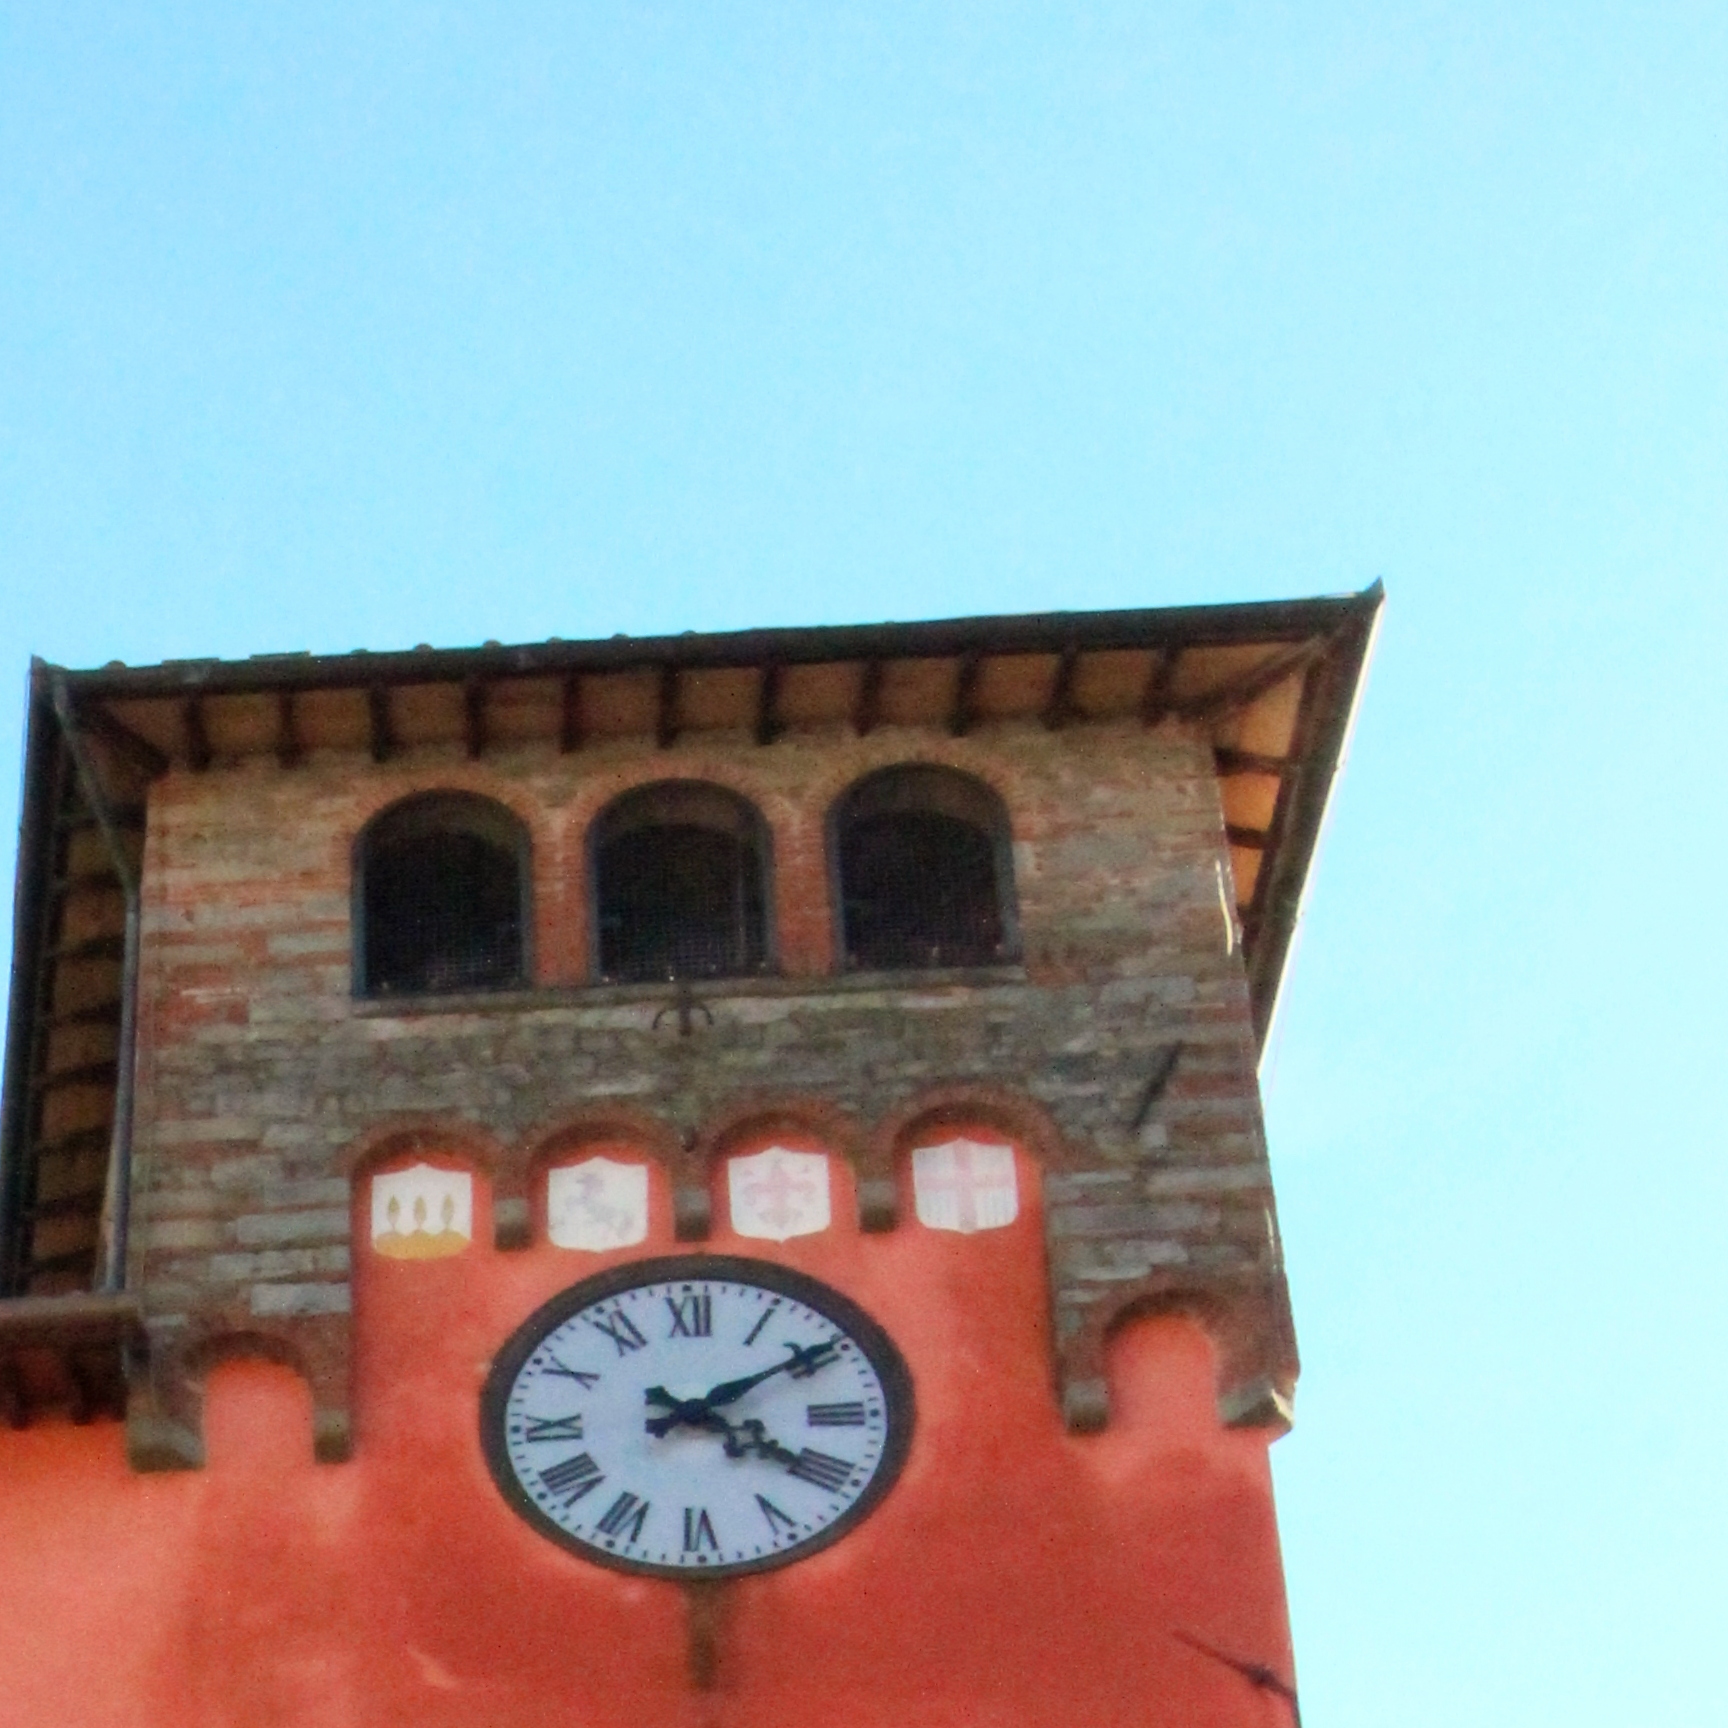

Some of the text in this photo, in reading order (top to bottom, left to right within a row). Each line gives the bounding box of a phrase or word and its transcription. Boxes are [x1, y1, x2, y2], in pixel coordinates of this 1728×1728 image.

[592, 1310, 648, 1357] XI
[666, 1294, 712, 1337] XII
[744, 1306, 775, 1346] I
[541, 1356, 600, 1391] X
[524, 1412, 584, 1443] IX
[806, 1401, 866, 1428] III
[538, 1450, 607, 1508] VIII
[595, 1490, 650, 1543] VII
[683, 1506, 720, 1552] VI
[754, 1493, 798, 1535] V
